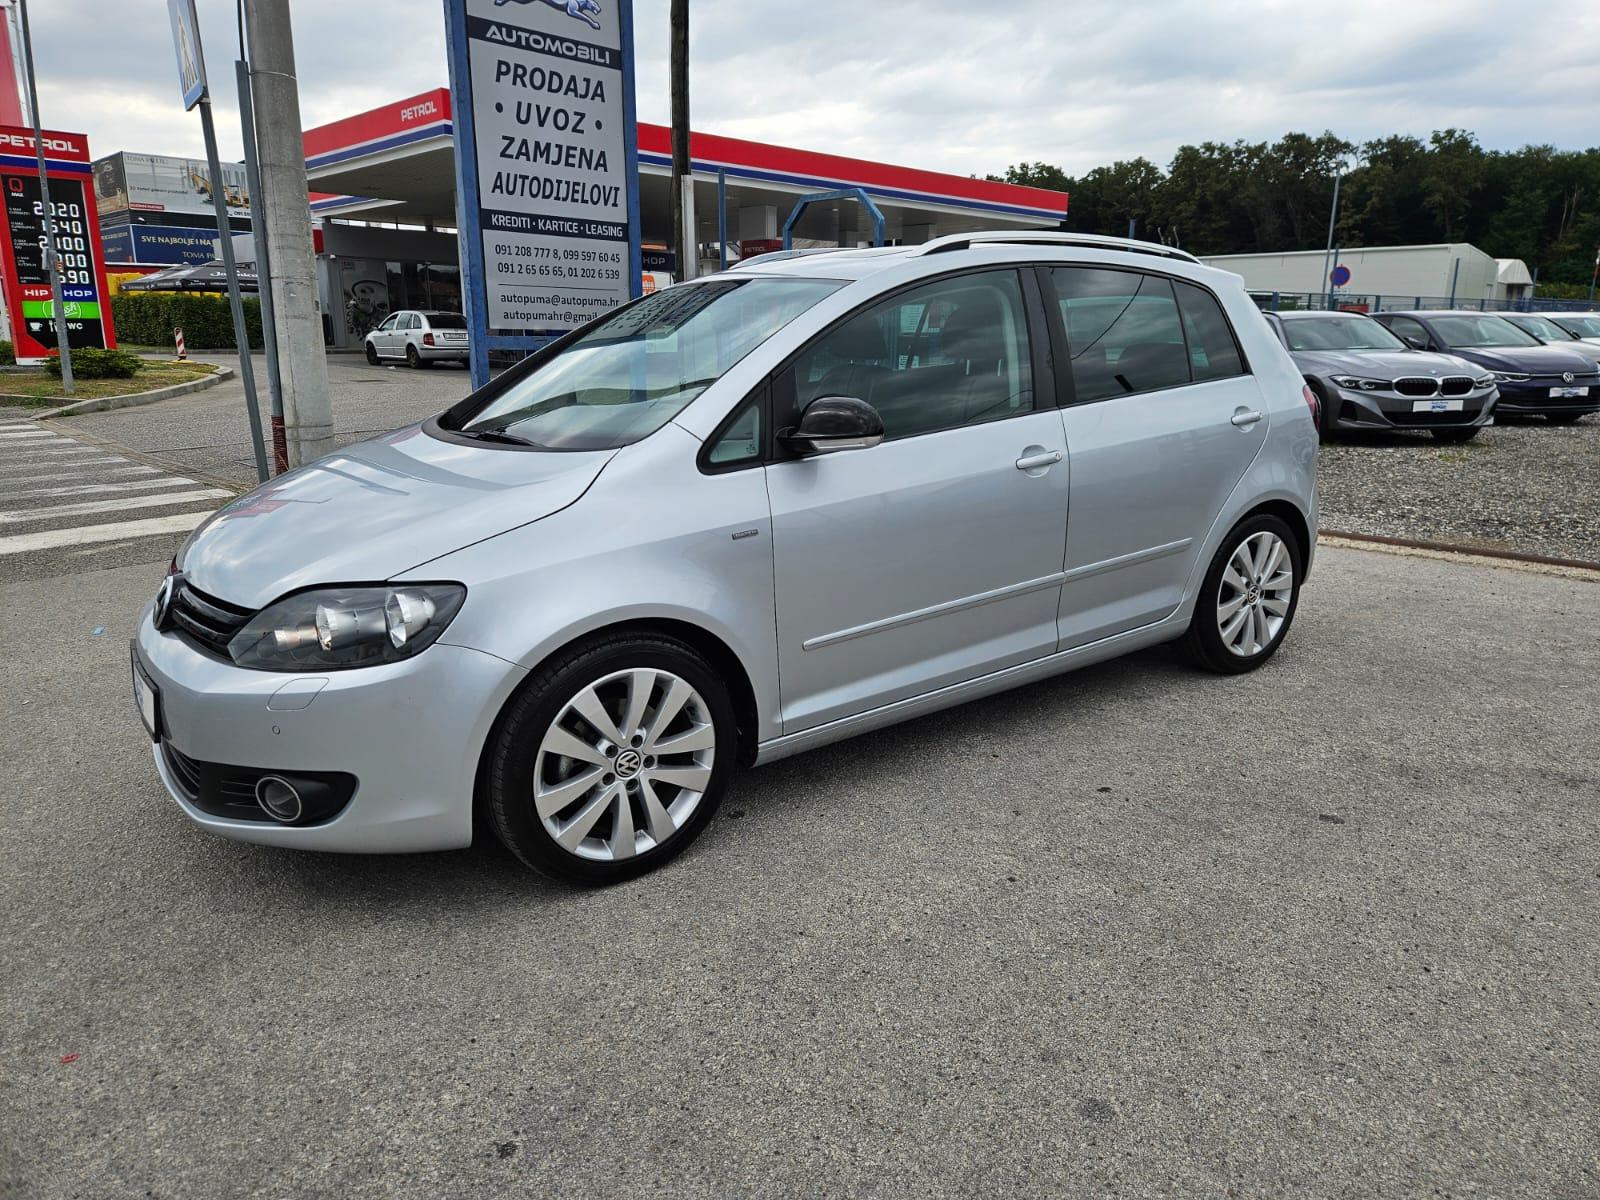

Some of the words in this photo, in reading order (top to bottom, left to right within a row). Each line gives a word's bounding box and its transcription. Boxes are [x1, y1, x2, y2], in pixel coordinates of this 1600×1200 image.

[486, 25, 610, 64] AUTOMOBILI
[495, 59, 606, 103] PRODAJA
[401, 100, 437, 122] PETROL
[516, 101, 586, 134] UVOZ
[0, 134, 80, 153] PETROL
[500, 135, 609, 173] ZAMJENA
[491, 171, 620, 207] AUTODIJELOVI
[491, 214, 531, 229] KREDITI
[538, 218, 579, 233] KARTICE
[585, 223, 623, 237] LEASING
[141, 235, 157, 243] SVE
[158, 236, 195, 246] NAJBOLJE
[495, 244, 512, 256] 091
[515, 245, 532, 257] 208
[534, 247, 551, 258] 777
[553, 249, 561, 260] 8,
[563, 249, 579, 260] 099
[581, 251, 596, 262] 597
[598, 252, 609, 262] 60
[610, 253, 621, 263] 45
[643, 256, 666, 265] HOP
[498, 262, 515, 274] 091
[517, 263, 523, 274] 2
[525, 264, 537, 275] 65
[539, 265, 550, 276] 65
[552, 266, 566, 278] 65,
[568, 267, 578, 278] 01
[581, 268, 596, 279] 202
[597, 269, 603, 279] 6
[605, 269, 620, 280] 539
[24, 289, 49, 297] HIP
[57, 289, 93, 297] HOP
[500, 293, 619, 307] autopuma@autopuma.hr
[67, 322, 84, 330] WC
[503, 311, 598, 323] autopumahr@gmail
